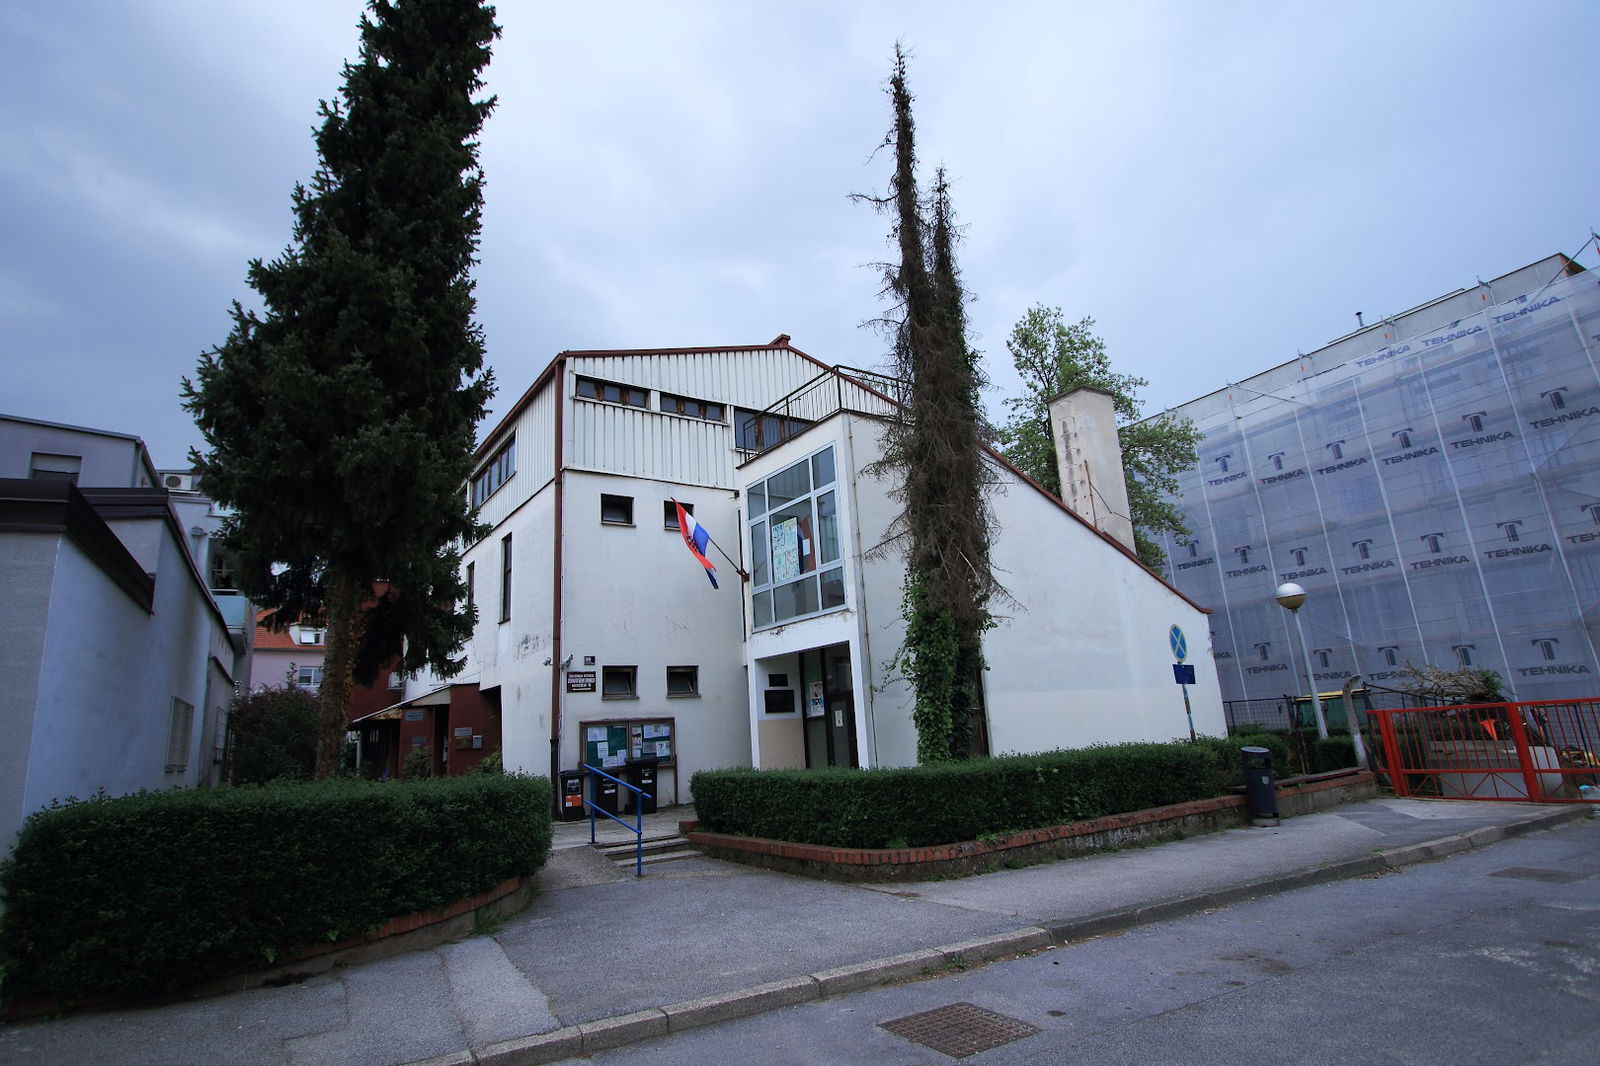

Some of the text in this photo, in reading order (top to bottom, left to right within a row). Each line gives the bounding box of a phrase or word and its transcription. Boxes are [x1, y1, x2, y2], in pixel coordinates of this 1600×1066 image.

[1492, 296, 1561, 323] TEHNIKA
[1421, 325, 1483, 346] TEHNIKA
[1355, 345, 1411, 367] TEHNIKA
[1529, 406, 1600, 430] TEHNIKA
[1450, 431, 1514, 449] TEHNIKA
[1382, 446, 1439, 465] TEHNIKA
[1316, 457, 1368, 475] TEHNIKA
[1208, 472, 1247, 486] TEHNIKA
[1260, 468, 1305, 485] TEHNIKA
[1483, 543, 1553, 559] TEHNIKA
[1177, 558, 1214, 570] TEHNIKA
[1226, 564, 1267, 577] TEHNIKA
[1341, 560, 1395, 575] TEHNIKA
[1410, 555, 1470, 570] TEHNIKA
[1280, 567, 1327, 580] TEHNIKA
[1246, 663, 1288, 675] TEHNIKA
[1517, 665, 1591, 676] TEHNIKA
